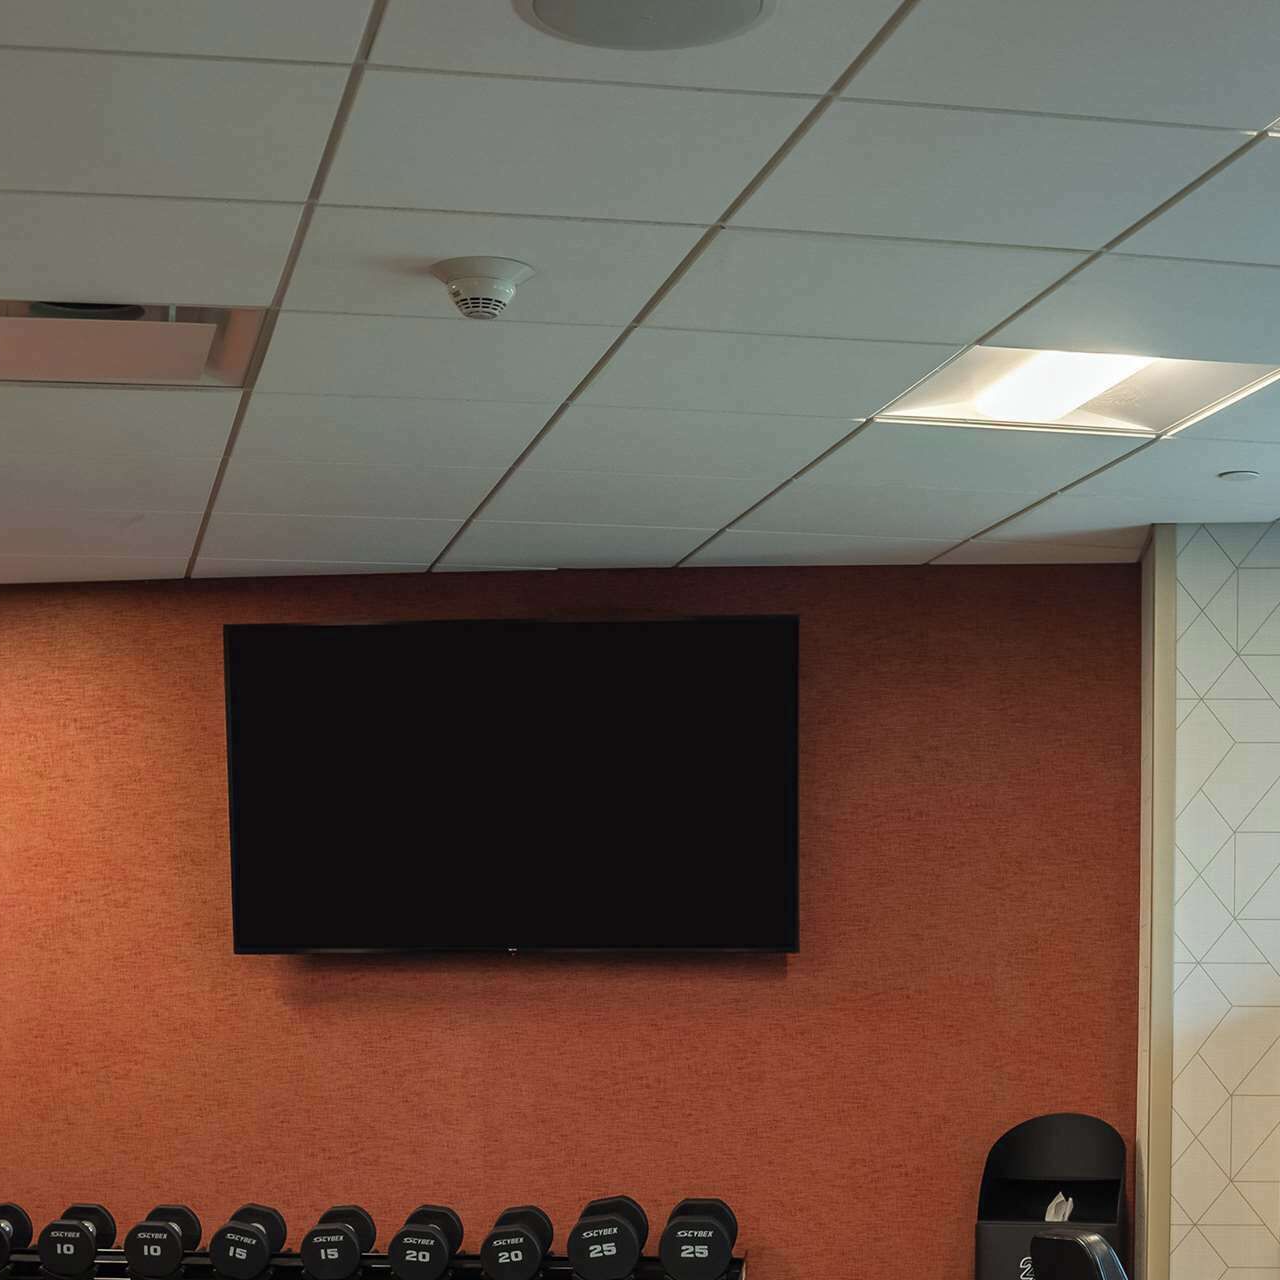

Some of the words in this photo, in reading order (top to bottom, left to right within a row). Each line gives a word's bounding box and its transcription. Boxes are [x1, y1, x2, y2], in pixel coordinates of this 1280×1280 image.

[57, 1244, 74, 1254] 10
[144, 1245, 161, 1255] 10
[229, 1247, 247, 1259] 15
[321, 1249, 338, 1259] 15
[589, 1243, 616, 1257] 25
[681, 1246, 708, 1257] 25
[406, 1250, 429, 1262] 20
[499, 1251, 522, 1263] 20
